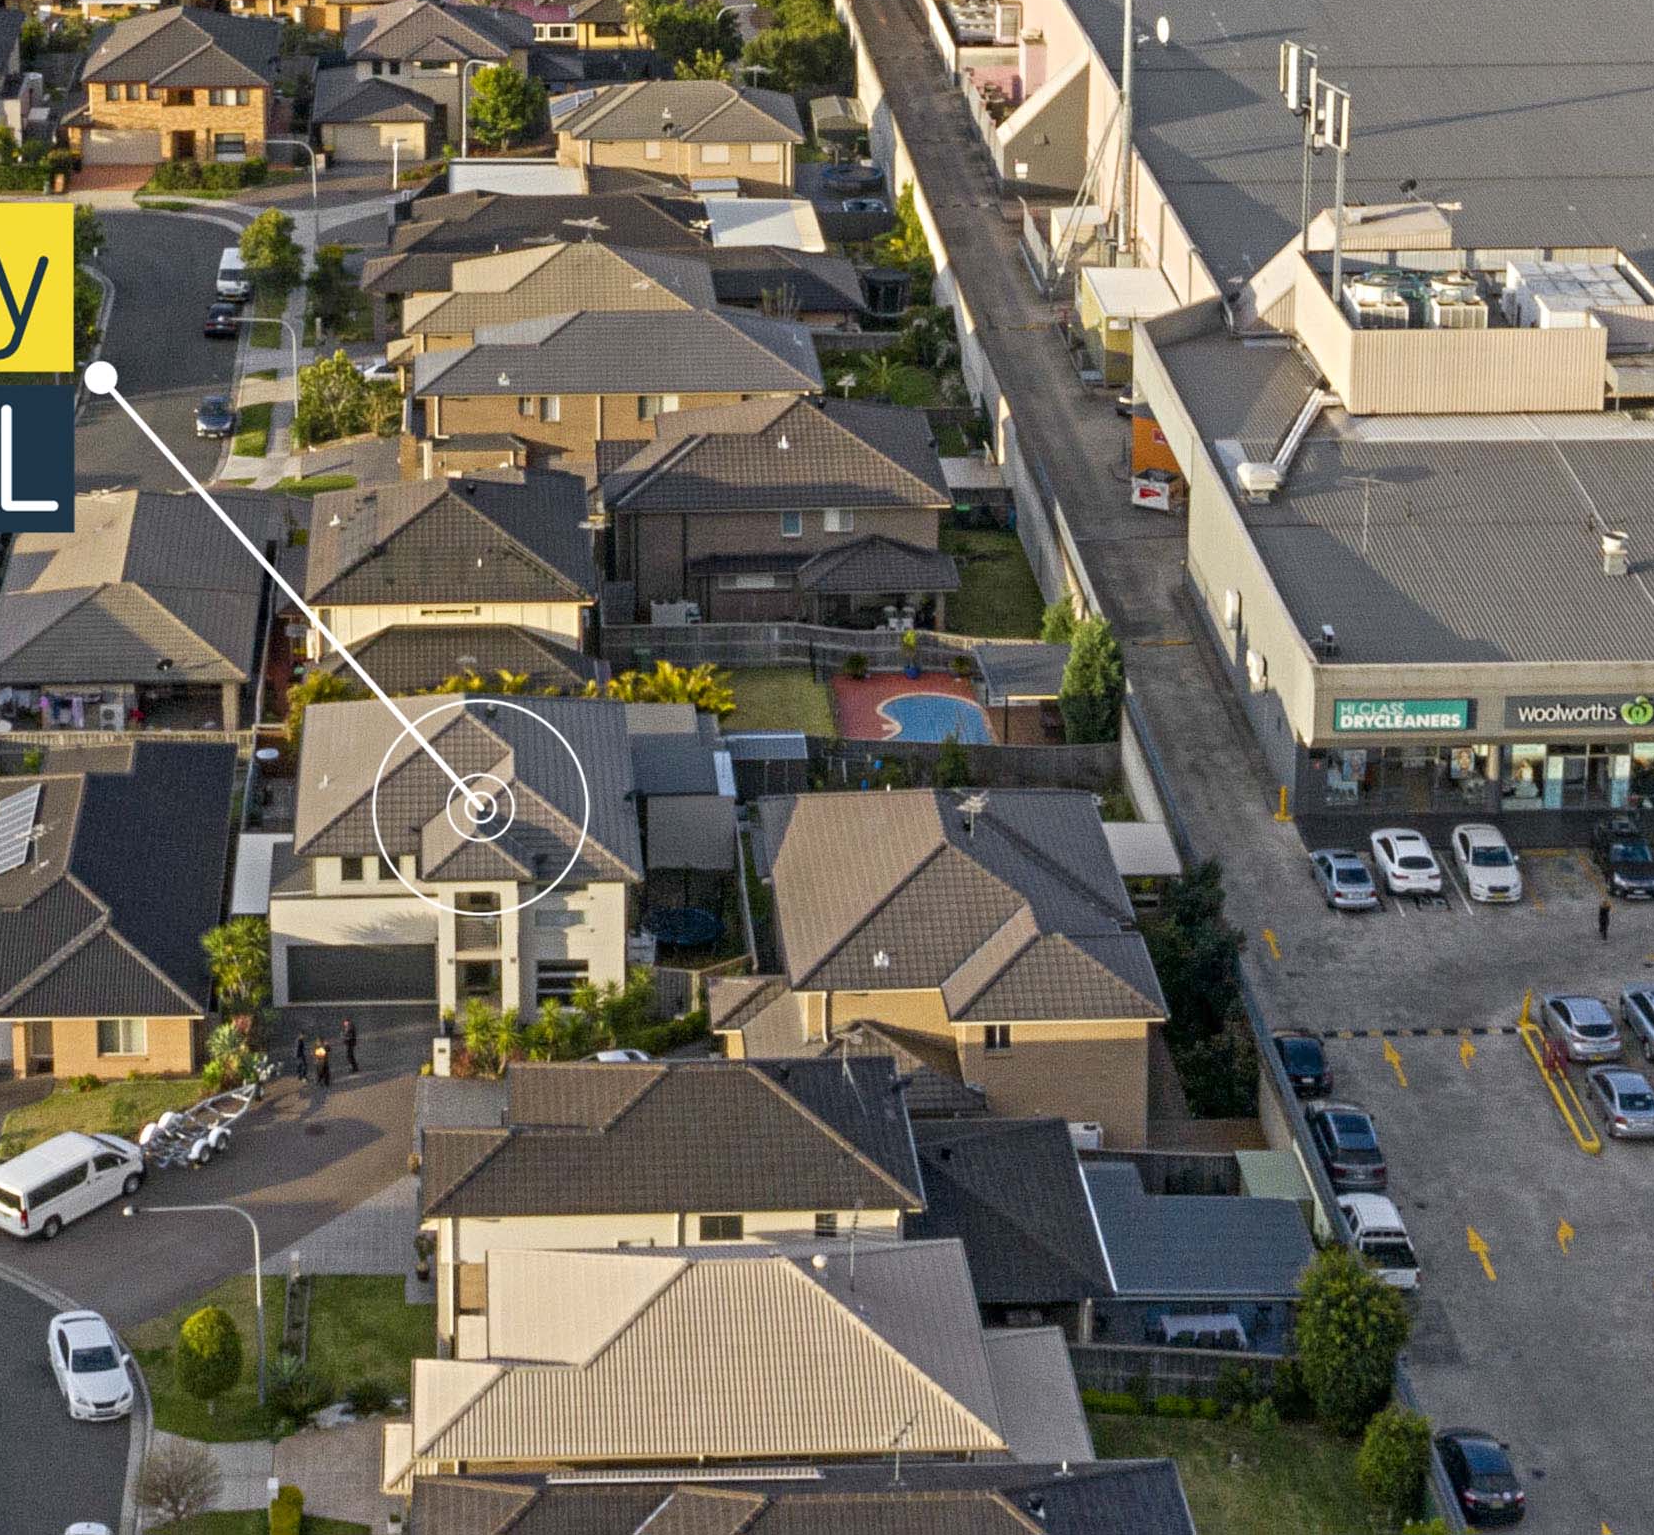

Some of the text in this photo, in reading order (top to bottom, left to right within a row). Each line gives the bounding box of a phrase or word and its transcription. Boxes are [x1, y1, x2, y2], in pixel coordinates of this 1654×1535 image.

[1340, 702, 1405, 715] HI CLASS
[1340, 714, 1462, 729] DRYCLEANERS
